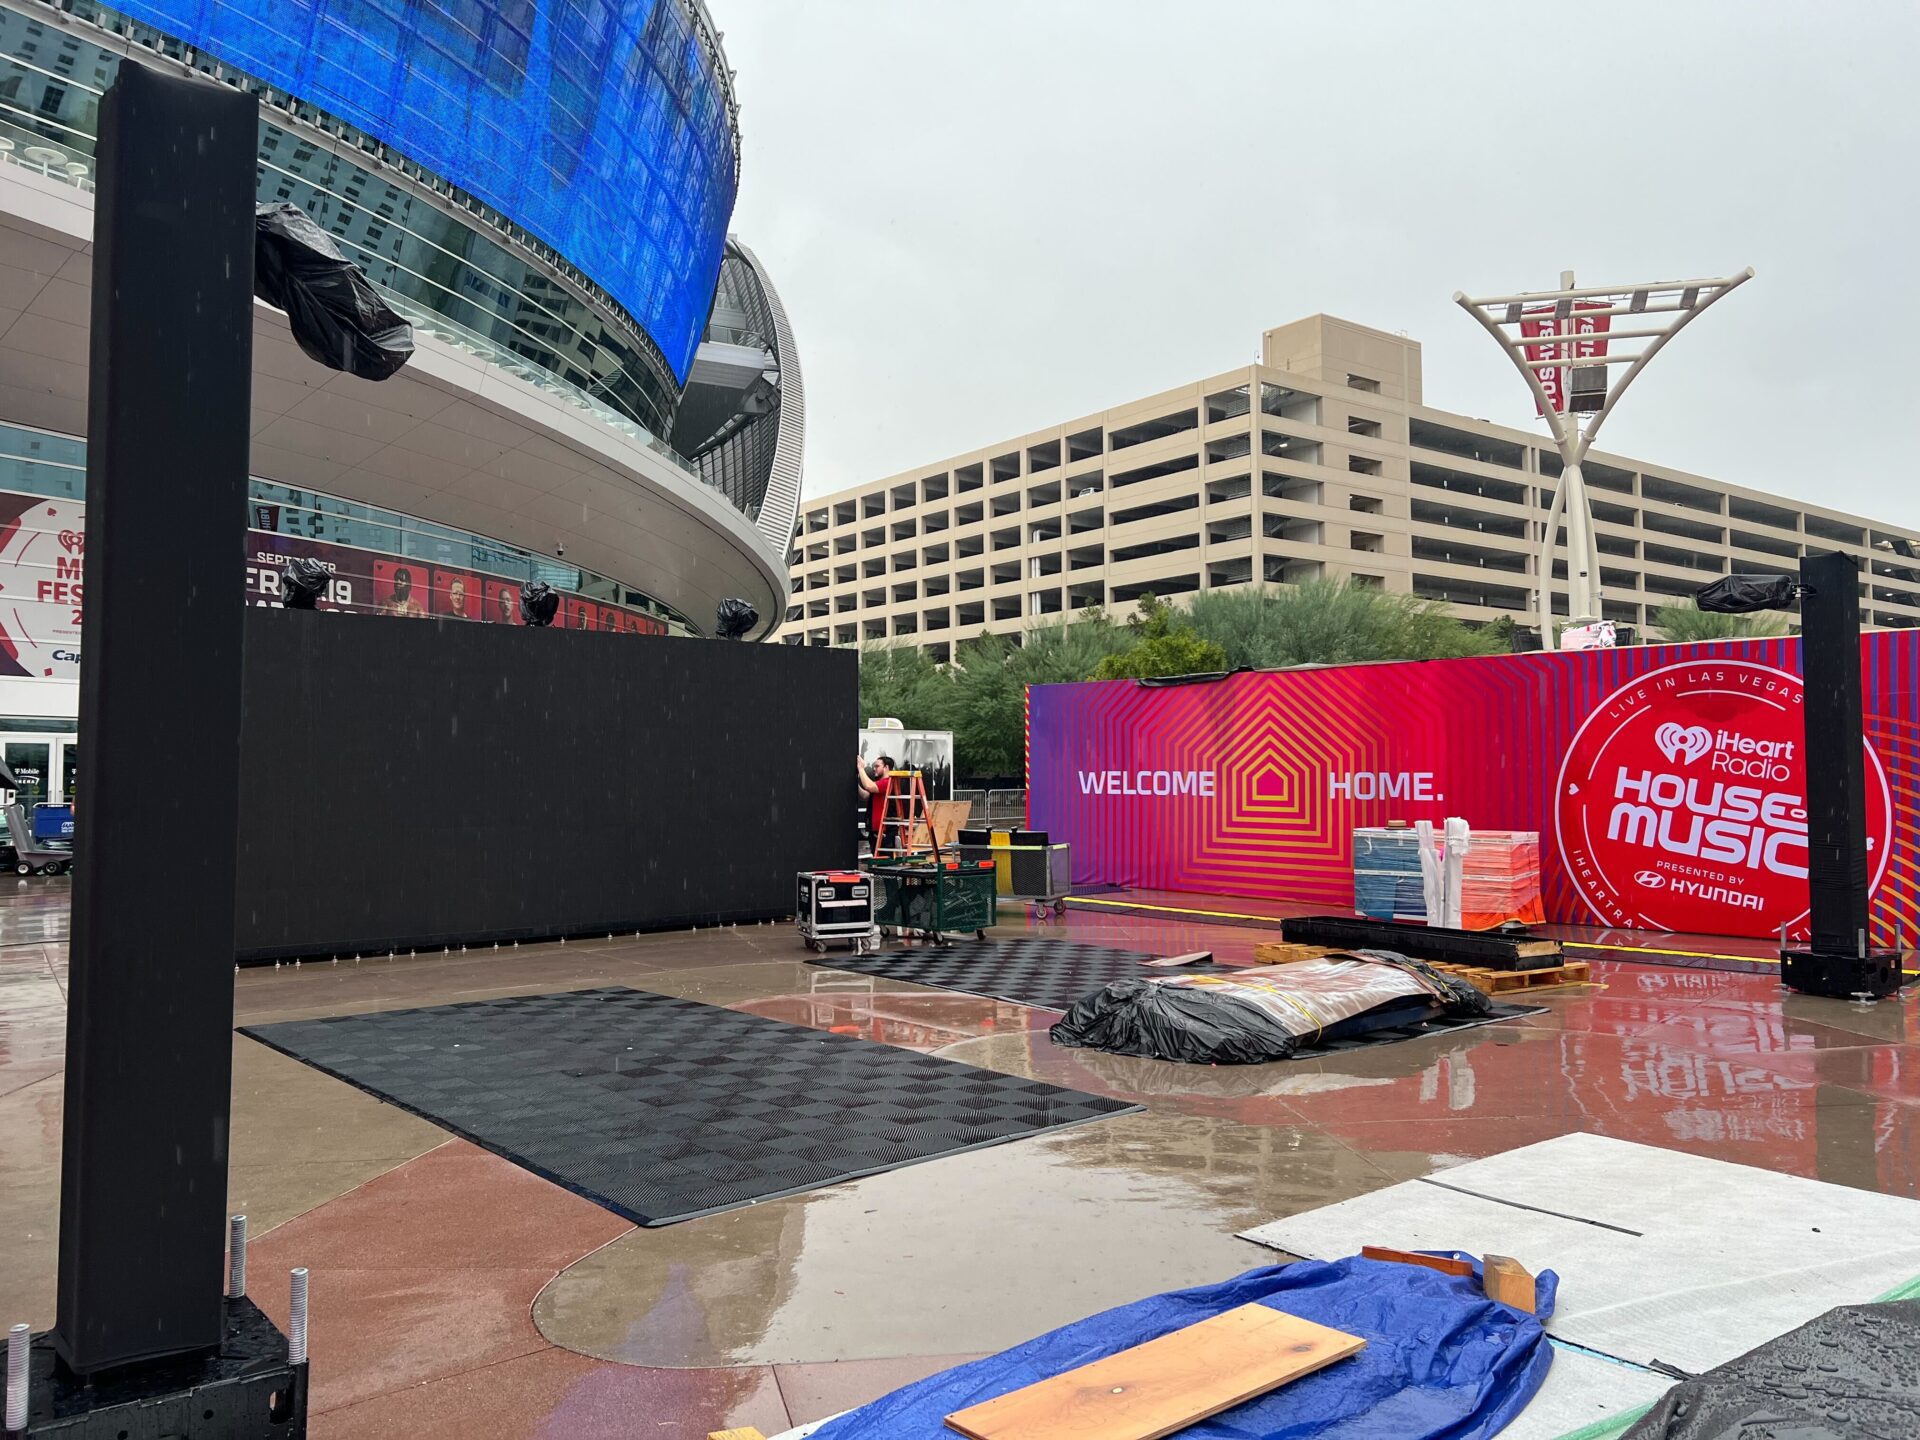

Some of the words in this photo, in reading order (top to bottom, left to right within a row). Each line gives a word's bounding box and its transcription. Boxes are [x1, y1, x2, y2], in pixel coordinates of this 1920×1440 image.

[257, 551, 337, 574] SEPTER
[37, 580, 84, 606] FES
[246, 567, 286, 600] FR
[329, 579, 352, 604] 19
[52, 649, 81, 664] Cap
[1609, 689, 1648, 719] LIVE
[1656, 676, 1677, 692] IN
[1688, 671, 1725, 683] LAS
[1739, 674, 1803, 704] VEGAS
[1715, 729, 1795, 761] iHeart
[1711, 751, 1791, 783] Radio
[1078, 770, 1216, 797] WELCOME
[1329, 771, 1444, 802] HOME.
[1613, 766, 1808, 830] HOUSE
[1607, 801, 1810, 880] MUSIC
[1656, 860, 1726, 882] PRESENTED
[1729, 874, 1745, 886] BY
[1573, 849, 1645, 930] IHEARTRA
[1670, 877, 1765, 912] HYUNDAI
